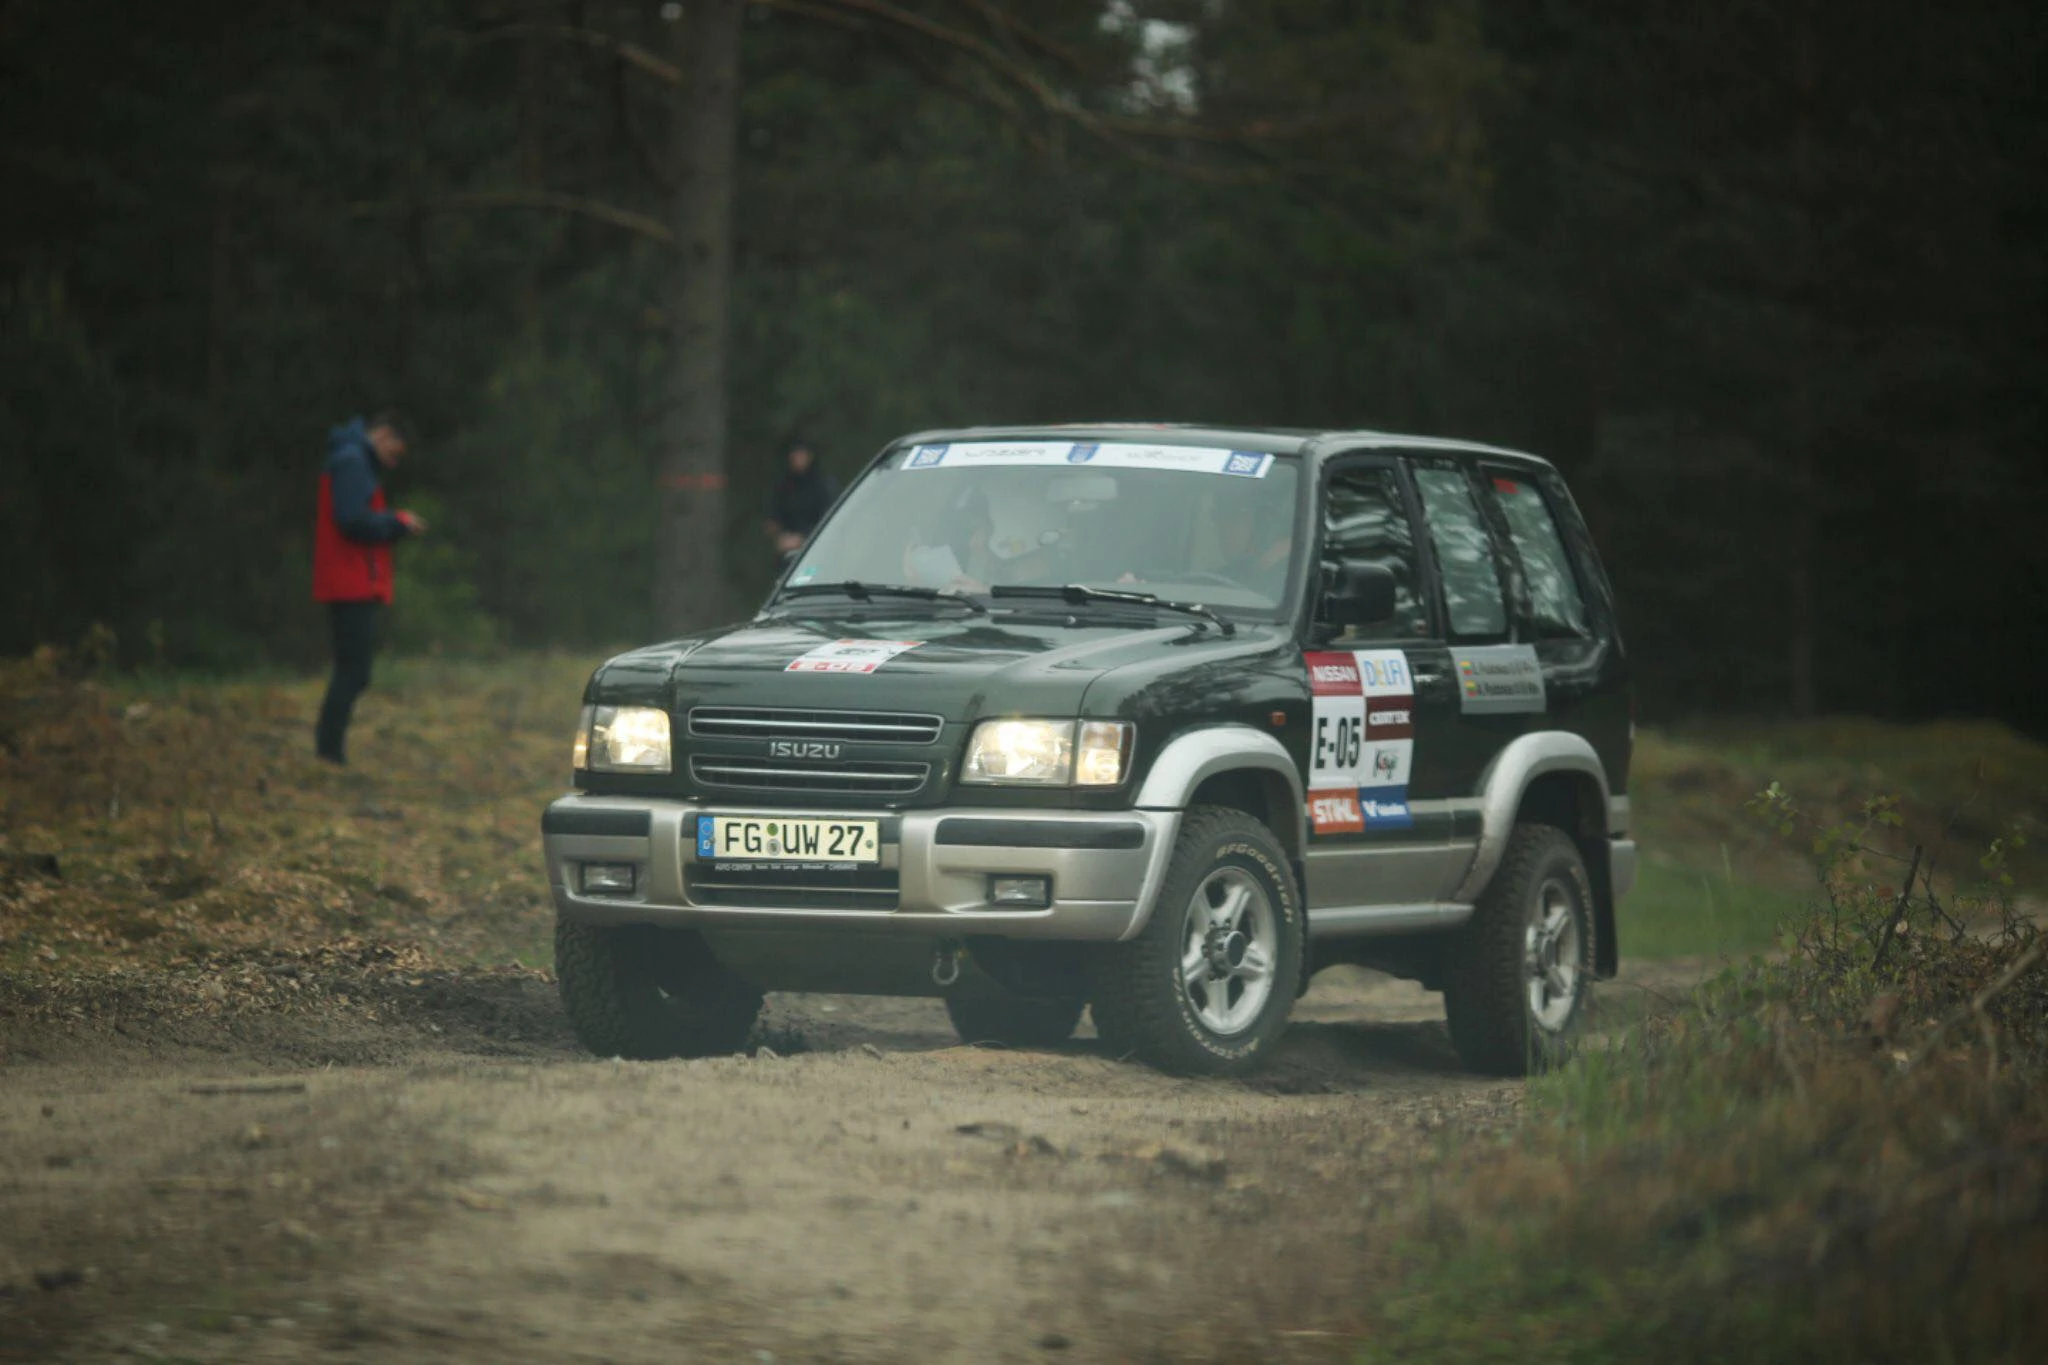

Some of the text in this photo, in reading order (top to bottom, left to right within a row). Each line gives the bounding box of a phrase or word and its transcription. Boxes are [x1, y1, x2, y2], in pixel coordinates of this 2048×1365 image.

[1312, 665, 1358, 683] NISSAN
[769, 741, 840, 759] ISUZU
[1315, 716, 1361, 769] E-05
[725, 822, 762, 853] FG
[783, 824, 820, 855] UW
[828, 825, 866, 856] 27
